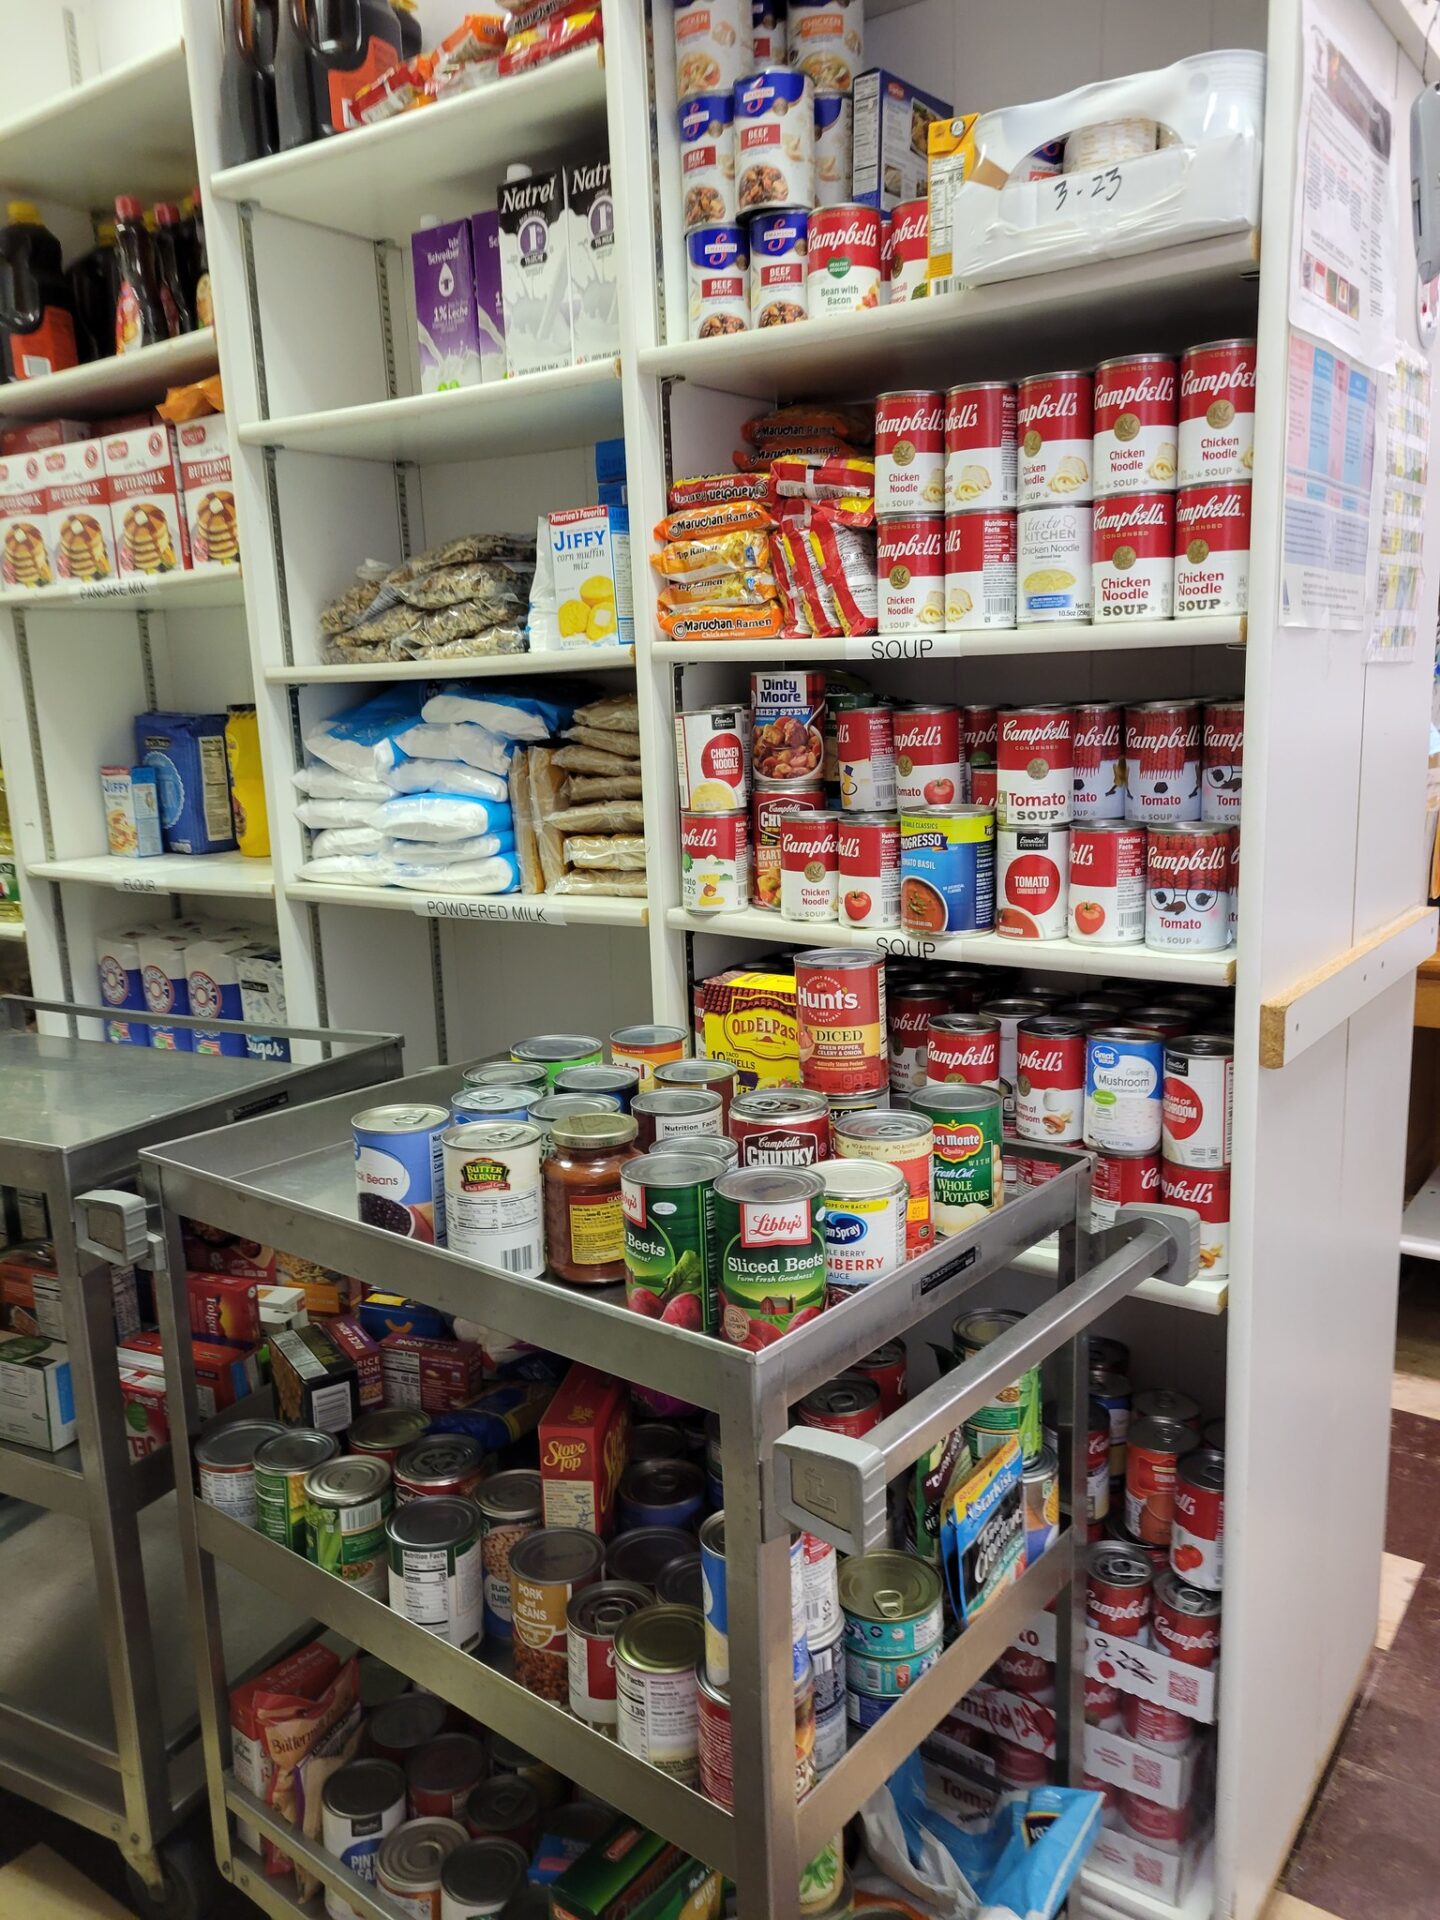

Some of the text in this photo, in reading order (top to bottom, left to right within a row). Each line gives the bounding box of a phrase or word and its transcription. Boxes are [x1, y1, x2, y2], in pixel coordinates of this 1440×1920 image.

[748, 128, 769, 140] BEEF
[572, 162, 610, 195] Natr
[501, 173, 555, 214] Natrel
[808, 221, 877, 253] Campbell's
[769, 266, 791, 276] BEEF
[711, 280, 732, 289] BEEF
[821, 285, 859, 296] Bean with
[827, 297, 852, 306] Bacon
[1094, 377, 1174, 410] Campbell's
[875, 408, 944, 436] Campbell's
[762, 426, 803, 436] Maruchan
[1201, 437, 1240, 449] Chicken
[756, 444, 840, 460] Maruchan Ramen
[1110, 449, 1145, 460] Chicken
[1202, 449, 1238, 460] Noodle
[1110, 461, 1143, 472] Noodle
[1204, 467, 1233, 476] SOUP
[113, 471, 165, 492] BUTTERMILK
[889, 473, 919, 482] Chicken
[1113, 479, 1139, 488] SOUP
[51, 483, 101, 502] BUTTERMILK
[709, 486, 758, 500] Maruchan
[890, 484, 918, 493] Noodle
[551, 507, 605, 524] America's Favorite
[1176, 495, 1241, 525] Campbell's
[677, 510, 760, 530] Maruchan Ramen
[1093, 503, 1164, 532] Campbell's
[554, 530, 606, 551] JIFFY
[1024, 529, 1076, 541] KITCHEN
[877, 534, 941, 561] Campbell's
[1022, 543, 1080, 555] Chicken Noodle
[557, 548, 605, 562] corn muffin
[573, 561, 589, 571] mix
[1178, 571, 1224, 583] Chicken
[1101, 577, 1151, 590] Chicken
[1178, 583, 1222, 596] Noodle
[886, 596, 915, 605] Chicken
[1102, 588, 1149, 601] Noodle
[888, 607, 913, 615] Noodle
[1103, 603, 1148, 616] SOUP
[1178, 599, 1221, 611] SOUP
[684, 618, 772, 631] Maruchan Ramen
[702, 630, 728, 638] Chicken
[871, 639, 933, 659] SOUP
[762, 679, 797, 693] Dinty
[760, 691, 801, 703] Moore
[780, 708, 810, 716] STEW
[1003, 719, 1071, 745] Campbell's
[1126, 725, 1199, 753] Campbell's
[711, 748, 739, 759] CHICKEN
[713, 757, 739, 769] NOODLE
[104, 780, 130, 793] JIFFY
[896, 786, 921, 797] Tomato
[1009, 793, 1066, 807] Tomato
[1140, 795, 1181, 806] Tomato
[1017, 810, 1059, 820] SOUP
[917, 860, 936, 870] BASIL
[1148, 846, 1225, 875] Campbell's
[123, 878, 157, 892] FLOUR
[1014, 876, 1049, 888] TOMATO
[801, 888, 830, 897] Chicken
[802, 897, 829, 906] Noodle
[427, 900, 547, 922] POWDERED MILK
[1160, 917, 1201, 930] Tomato
[876, 937, 936, 959] SOUP
[798, 986, 859, 1010] Hunt's
[732, 1017, 772, 1036] OLD EL
[816, 1030, 863, 1042] DICED
[711, 1051, 725, 1062] 10
[927, 1041, 995, 1069] Campbell's
[727, 1058, 756, 1070] SHELLS
[1098, 1075, 1149, 1087] Mushroom
[1181, 1098, 1191, 1106] OF
[664, 1120, 717, 1132] Nutrition Facts
[758, 1136, 801, 1150] Campbell's
[932, 1134, 979, 1145] Del Monte
[747, 1146, 814, 1166] CHUNKY
[943, 1147, 965, 1155] Quality
[969, 1158, 990, 1167] WITH
[466, 1166, 503, 1175] BUTTER
[933, 1168, 955, 1178] Fresh
[366, 1174, 398, 1186] Beans
[468, 1172, 503, 1182] KERNEL
[937, 1179, 972, 1191] WHOLE
[943, 1190, 990, 1202] POTATOES
[750, 1213, 802, 1236] Libby's
[836, 1223, 861, 1240] Spray
[628, 1232, 666, 1257] Beets
[727, 1254, 824, 1274] Sliced Beets
[827, 1257, 884, 1271] NBERRY
[737, 1271, 815, 1283] Farm Fresh Goodness!
[828, 1272, 850, 1280] AUCE
[357, 1356, 380, 1367] RICE
[358, 1365, 381, 1377] RONI
[544, 1440, 587, 1467] Stove
[560, 1457, 582, 1473] Top
[972, 1471, 1013, 1521] StarKist
[403, 1551, 446, 1560] Nutrition Facts
[518, 1583, 544, 1600] PORK
[518, 1602, 548, 1621] BEANS
[630, 1704, 646, 1717] 130
[351, 1855, 377, 1870] PINT
